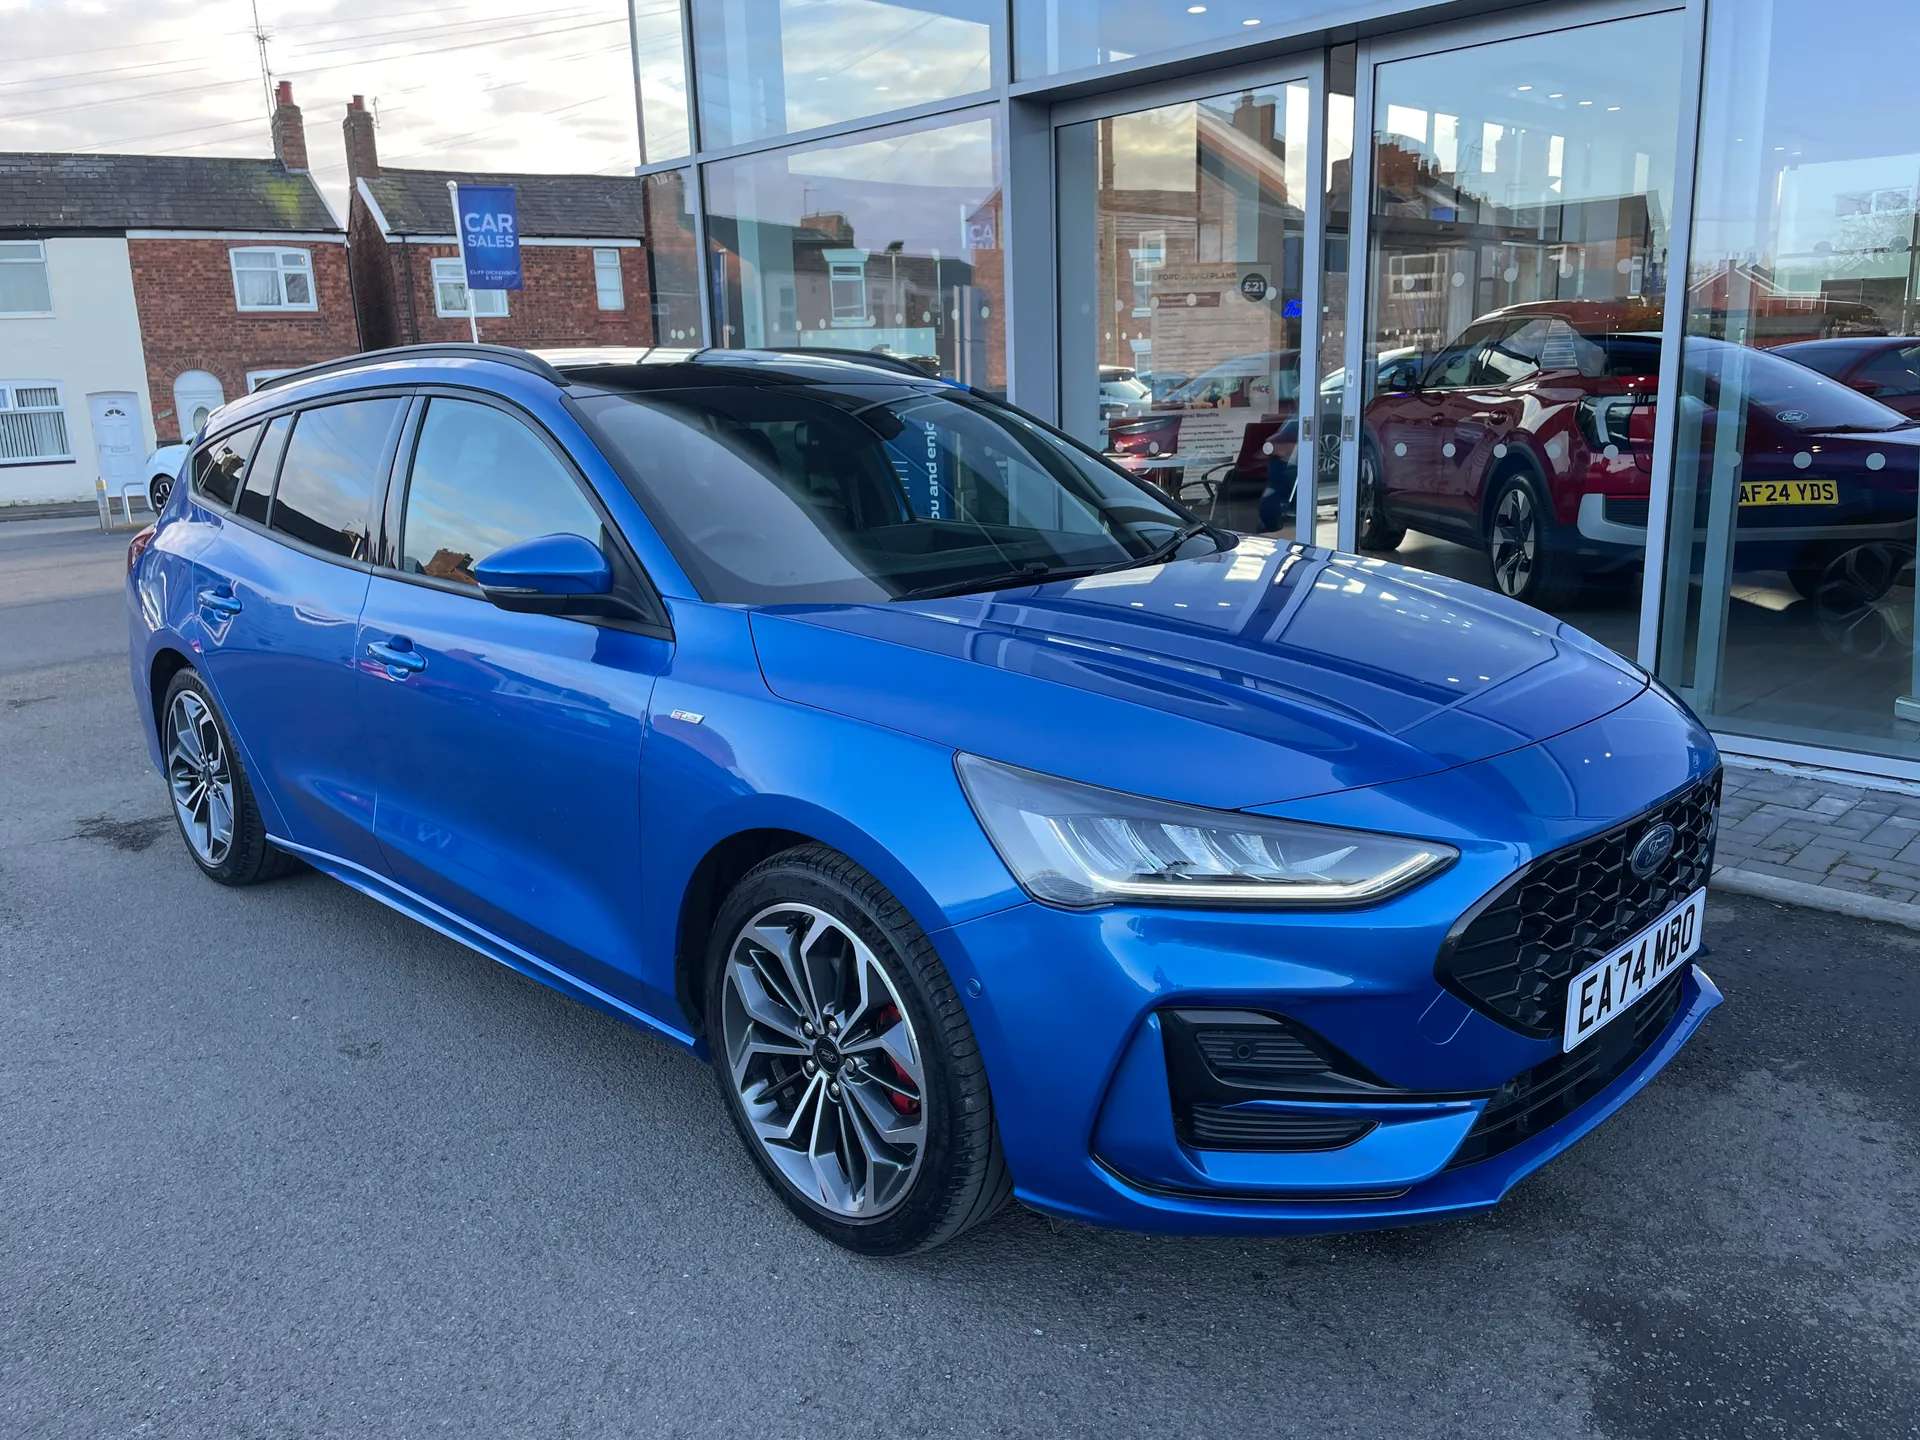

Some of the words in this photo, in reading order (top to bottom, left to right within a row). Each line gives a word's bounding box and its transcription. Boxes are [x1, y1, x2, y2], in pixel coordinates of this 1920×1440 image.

[464, 212, 514, 233] CAR
[467, 234, 515, 248] SALES
[926, 462, 939, 497] and
[1739, 484, 1791, 502] AF24
[1796, 483, 1834, 501] YDS
[1577, 939, 1647, 1034] EA74
[1652, 903, 1696, 978] MBO
